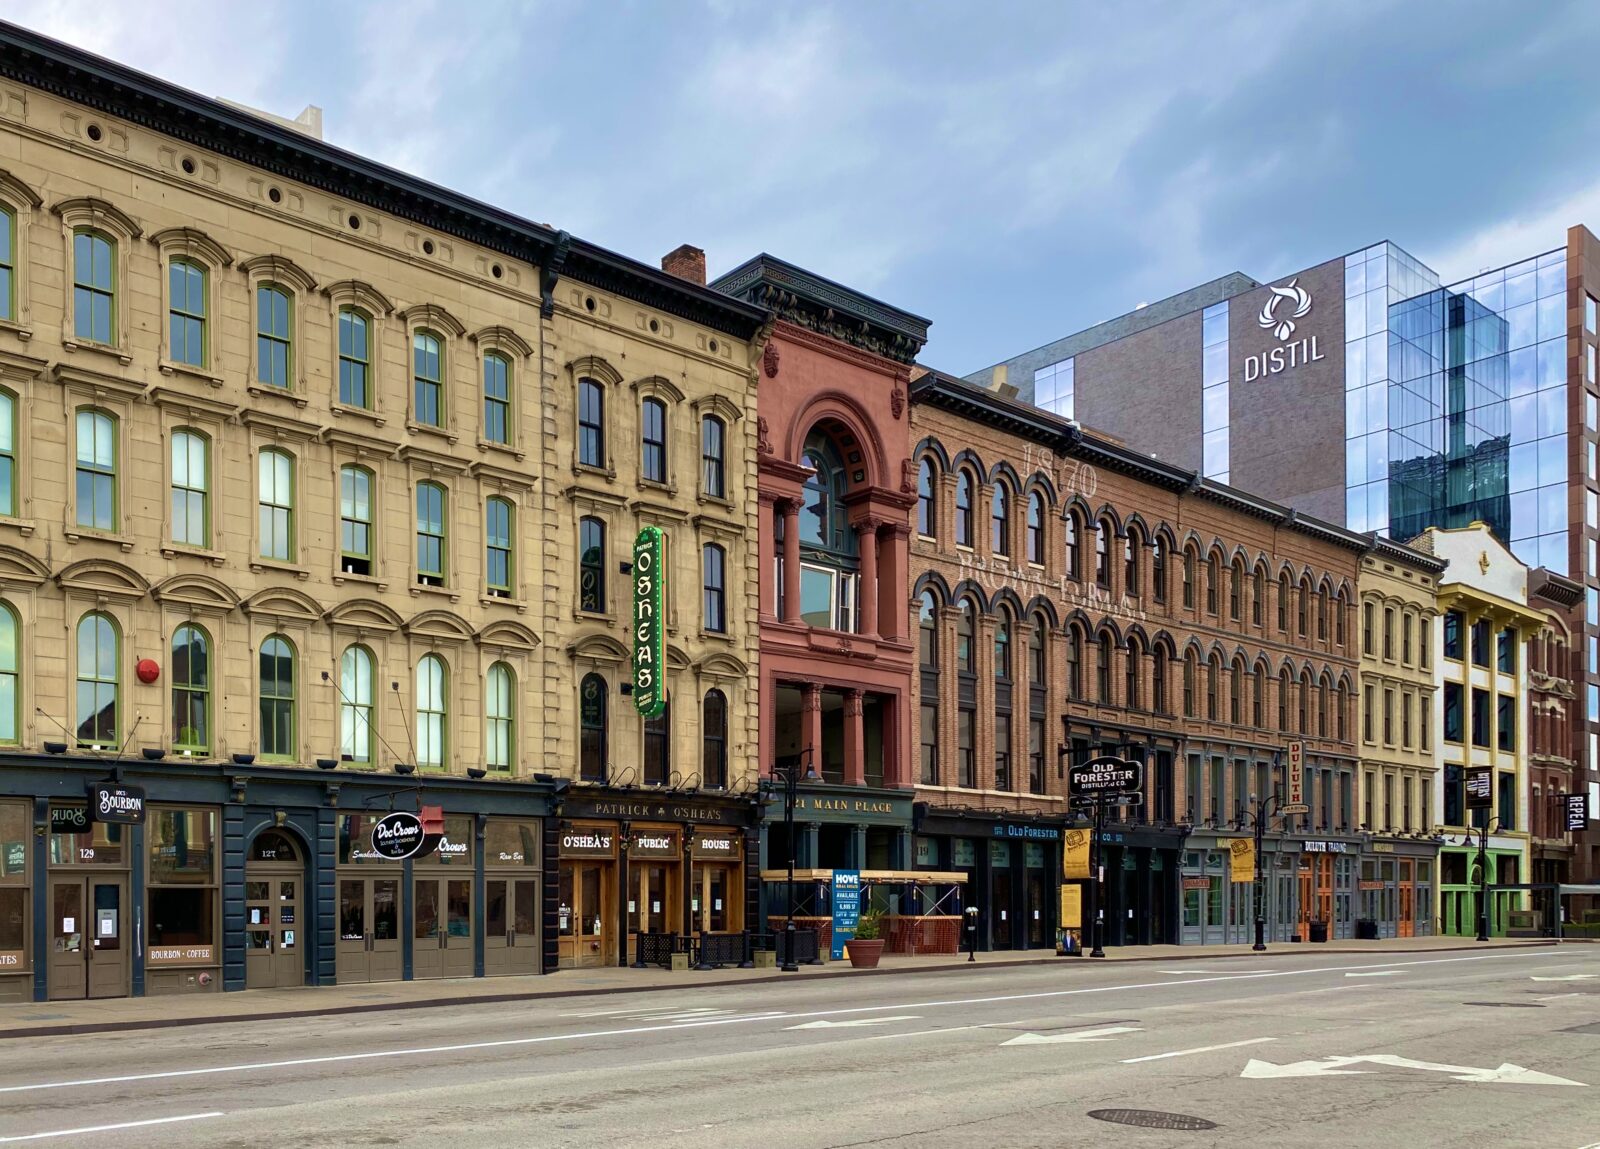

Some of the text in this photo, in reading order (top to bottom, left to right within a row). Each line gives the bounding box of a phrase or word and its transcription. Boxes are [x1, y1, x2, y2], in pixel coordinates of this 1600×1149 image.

[1245, 335, 1325, 382] DISTIL
[1020, 443, 1097, 498] 1870
[1092, 764, 1114, 773] OLD
[1291, 744, 1300, 802] DULUTH
[1074, 770, 1133, 783] FORESTER
[1478, 772, 1490, 797] BITTERS
[99, 790, 142, 814] BOURBON
[814, 799, 848, 811] MAIN
[855, 801, 892, 813] PLACE
[595, 803, 721, 820] PATRICK O'SHEA'S
[1569, 796, 1584, 830] REPEAL
[377, 823, 393, 839] Doc
[1008, 825, 1023, 836] OLD
[1024, 826, 1058, 838] FORESTER
[563, 836, 610, 849] O'SHEA'S
[638, 838, 669, 849] PUBLIC
[701, 839, 730, 850] HOUSE
[1305, 841, 1326, 852] DULUTH
[80, 848, 95, 859] 129
[262, 850, 276, 858] 127
[499, 852, 524, 861] Raw Bar
[836, 874, 858, 884] HOWE
[151, 949, 210, 959] BOURBON COFFEE
